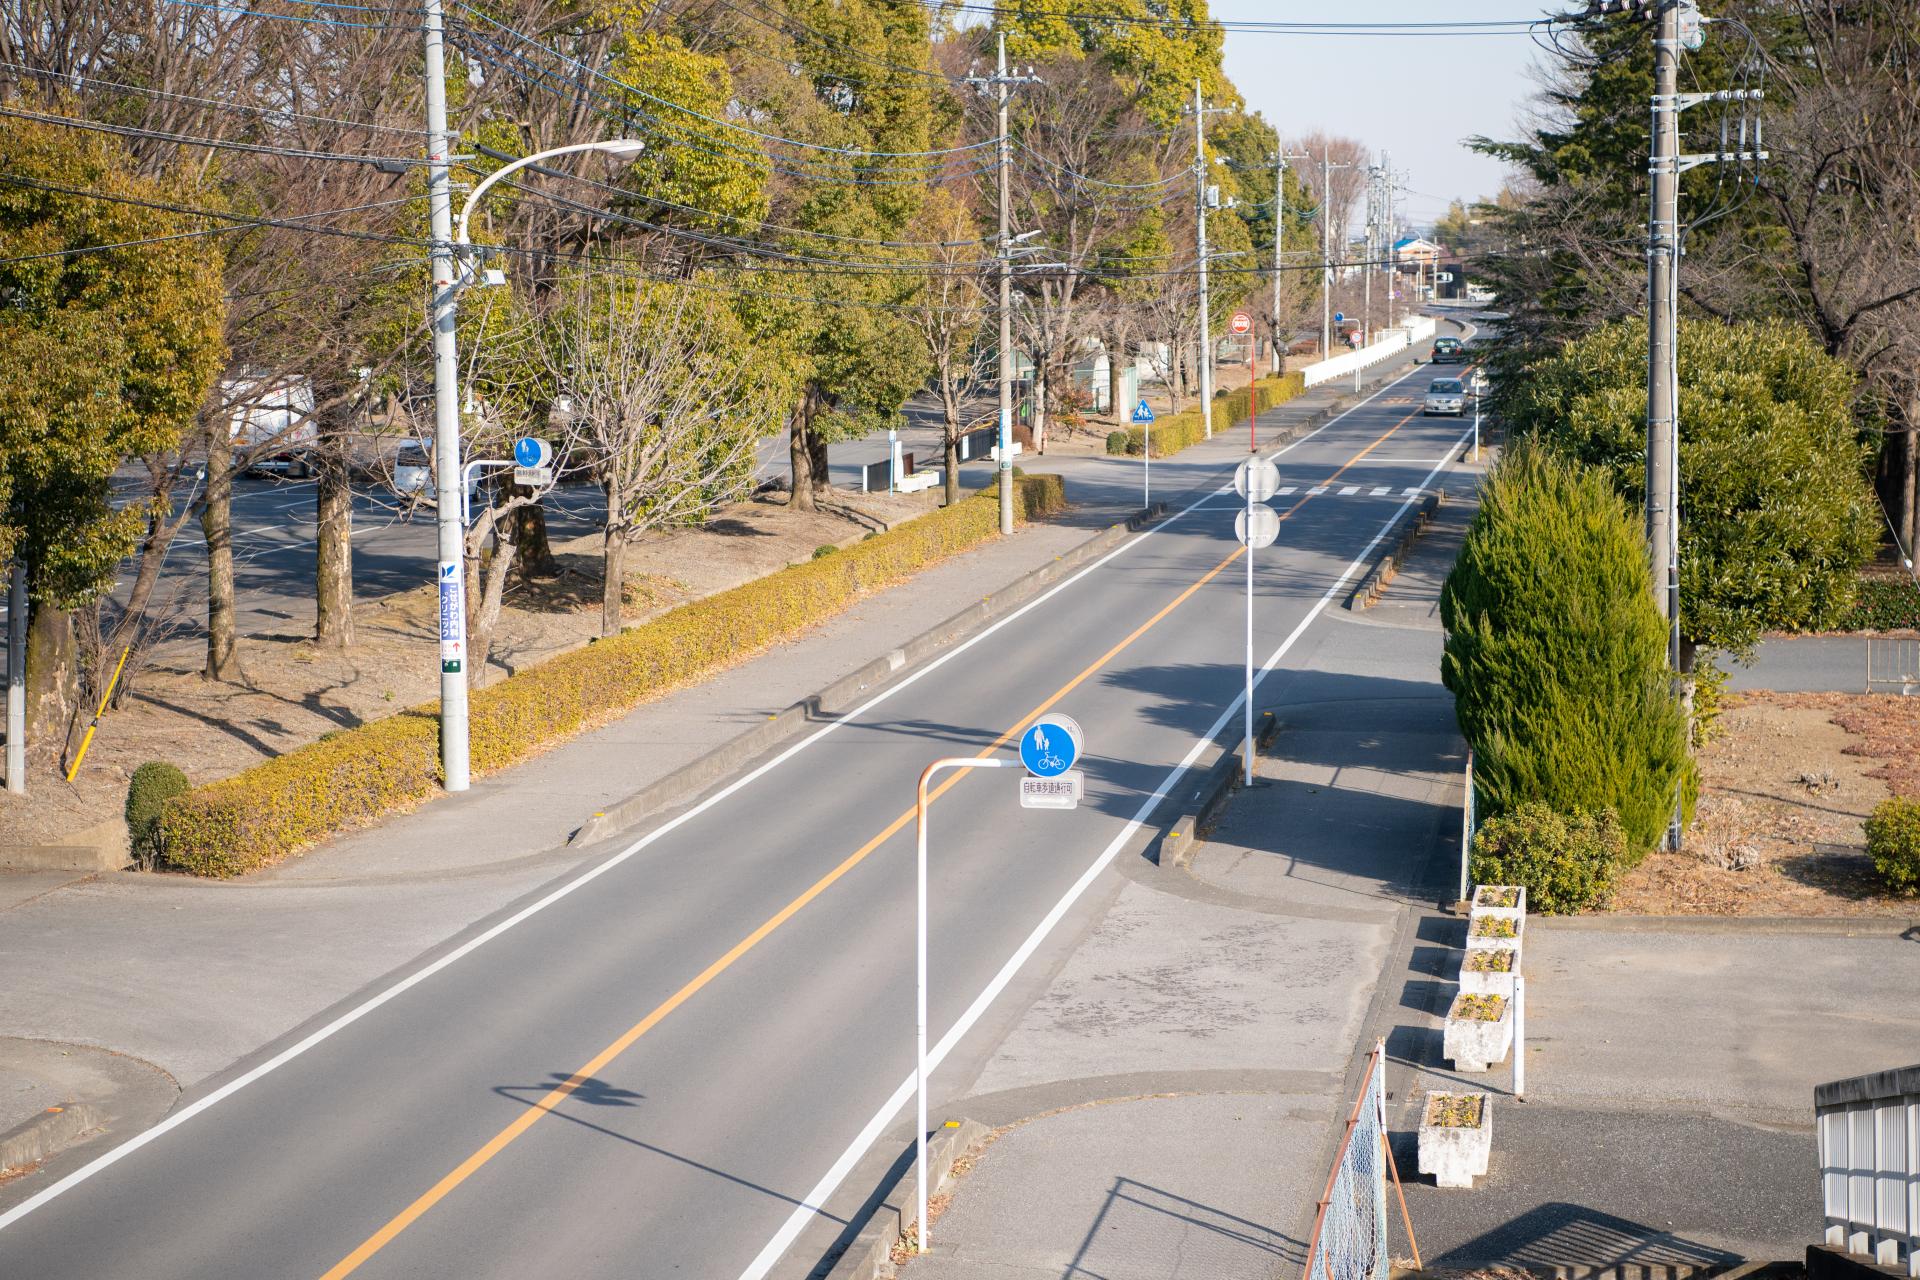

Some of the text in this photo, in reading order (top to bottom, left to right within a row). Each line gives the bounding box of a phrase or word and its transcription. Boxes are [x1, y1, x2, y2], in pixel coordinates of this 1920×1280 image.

[441, 595, 449, 637] クリニック
